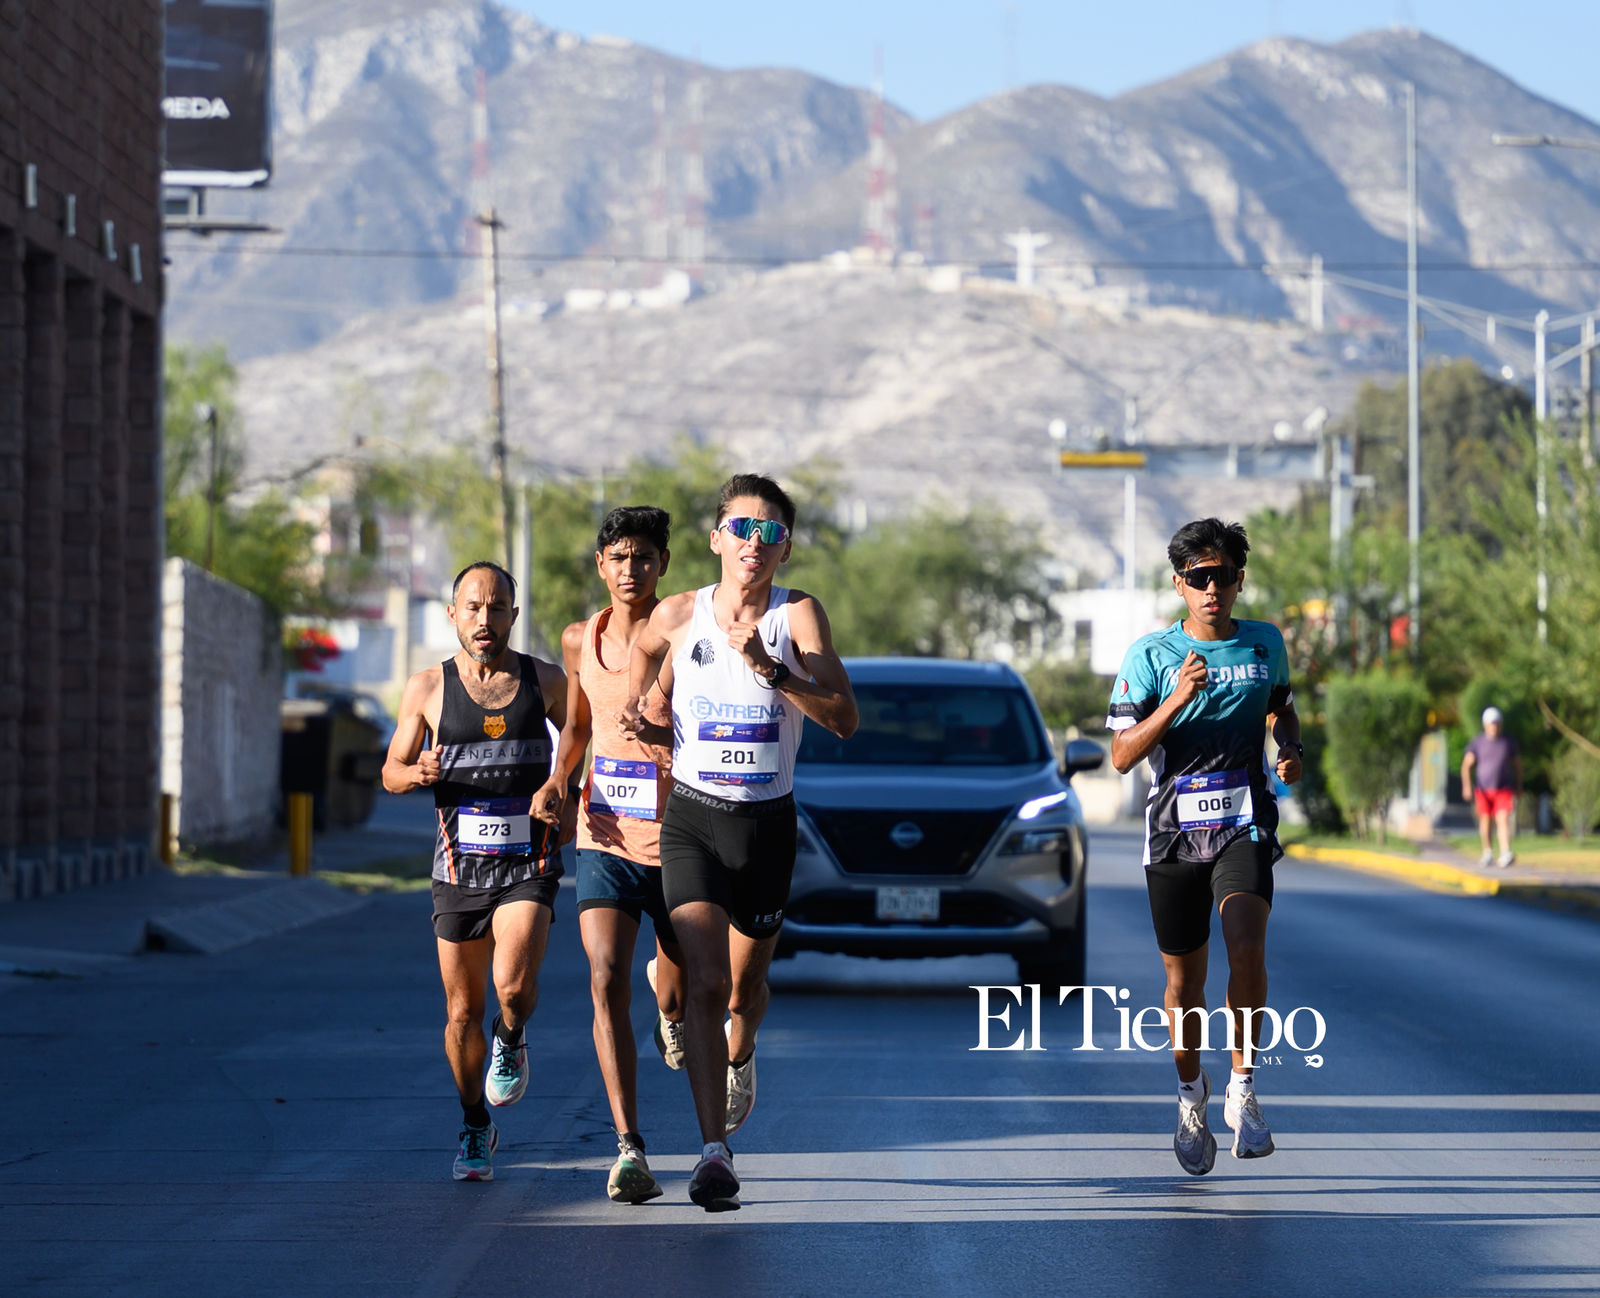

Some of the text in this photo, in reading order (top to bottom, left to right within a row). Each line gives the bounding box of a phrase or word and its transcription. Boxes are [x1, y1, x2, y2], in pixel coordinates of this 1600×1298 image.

[1168, 663, 1269, 686] CONES
[696, 701, 786, 719] ENTRENA
[721, 749, 757, 765] 201
[606, 784, 638, 799] 007
[673, 783, 741, 812] COMBAT
[1198, 796, 1232, 812] 006
[478, 823, 511, 837] 273
